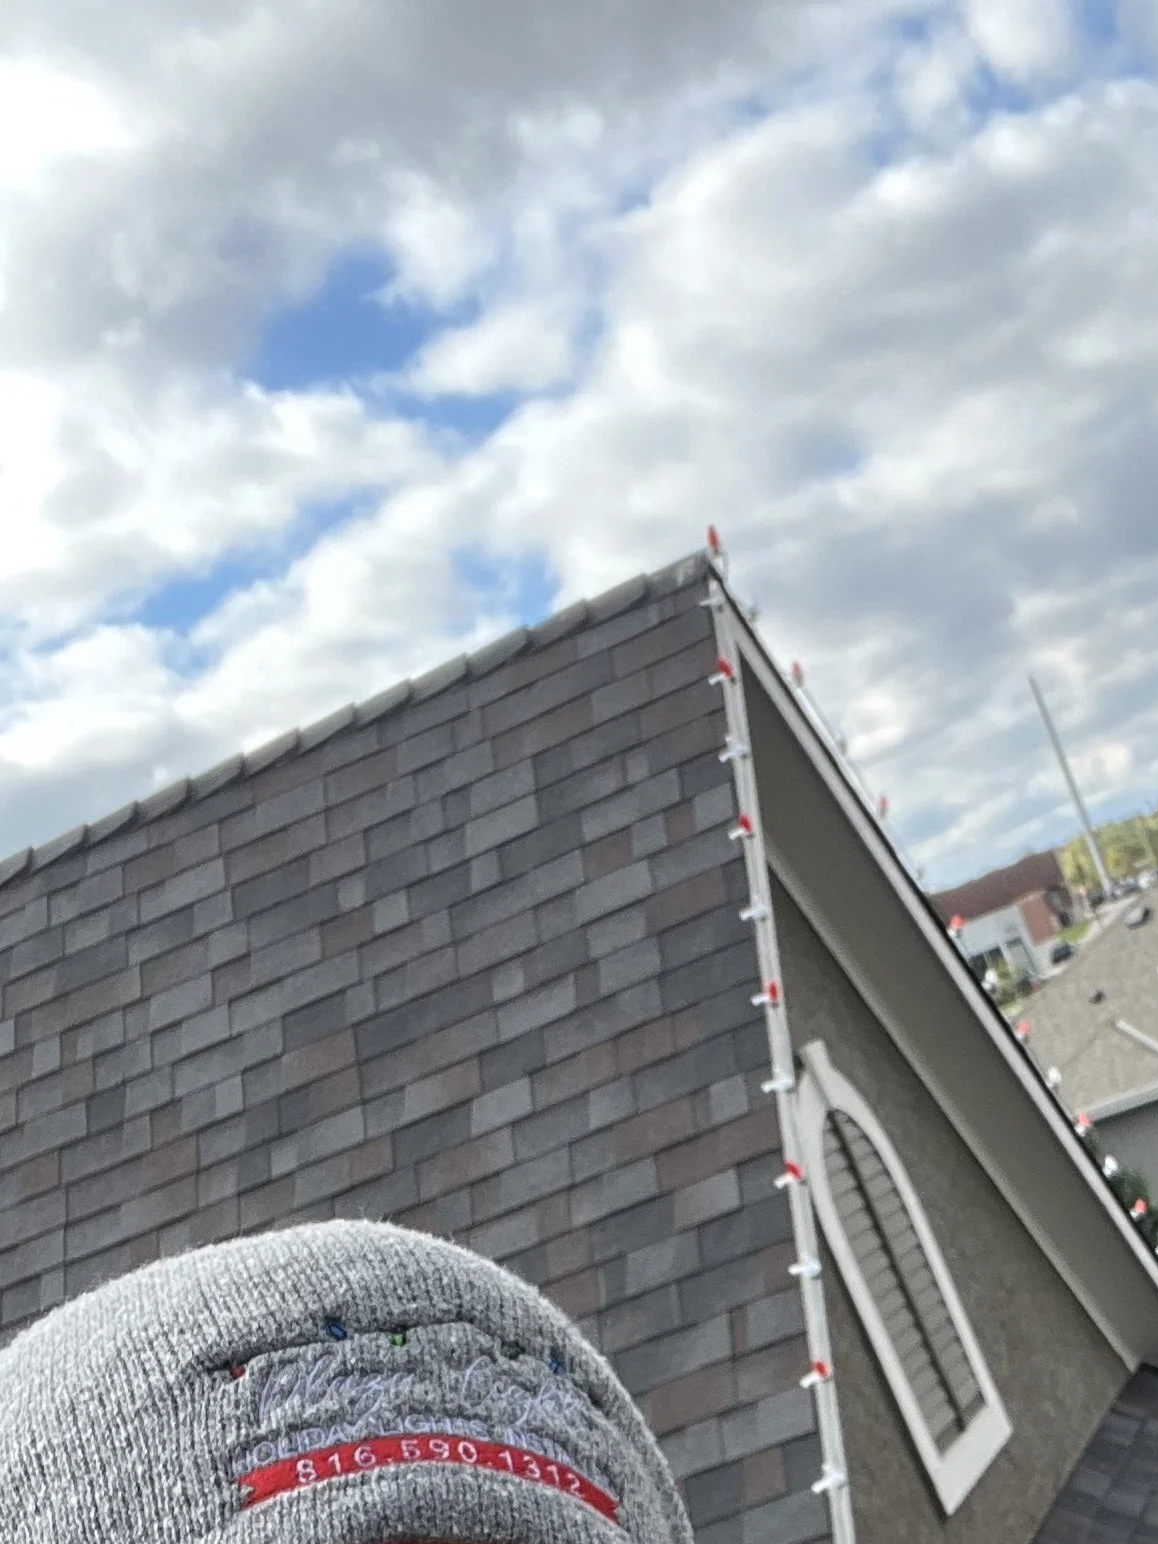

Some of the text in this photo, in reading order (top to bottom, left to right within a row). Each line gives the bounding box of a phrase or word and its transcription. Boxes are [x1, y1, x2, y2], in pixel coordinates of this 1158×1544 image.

[232, 1413, 491, 1475] HOLIDAY LIGHTS
[296, 1438, 584, 1498] 816.590.1312
